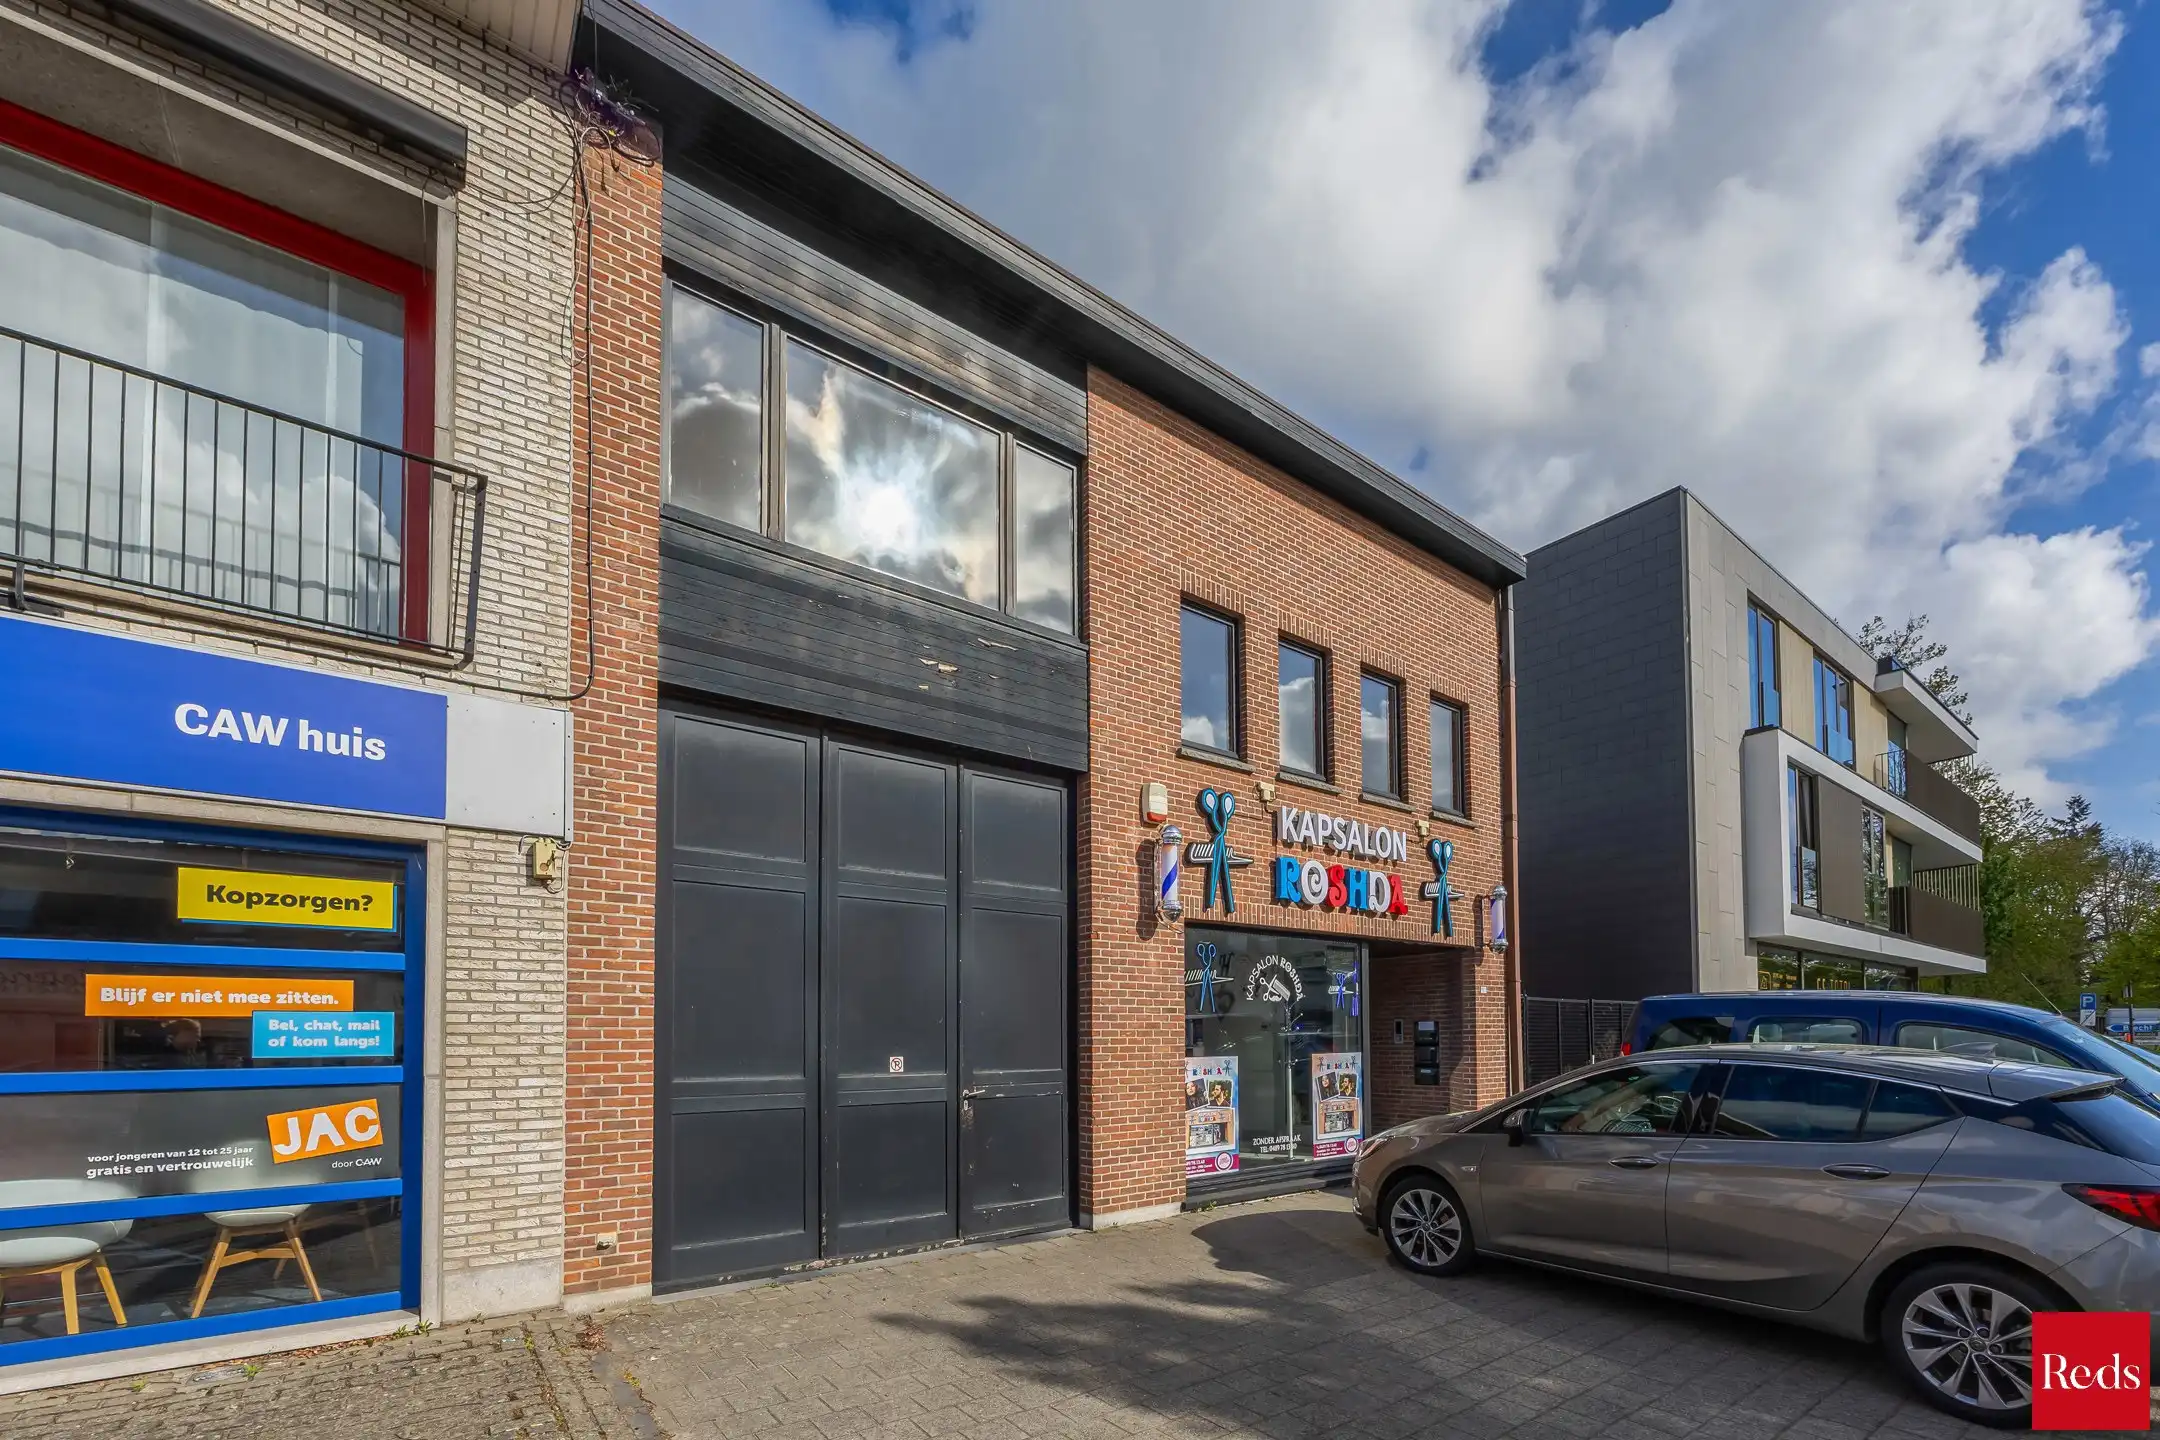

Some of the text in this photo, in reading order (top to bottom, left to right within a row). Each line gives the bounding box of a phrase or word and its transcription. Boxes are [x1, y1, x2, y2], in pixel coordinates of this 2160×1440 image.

[174, 703, 386, 761] CAW huis
[1278, 806, 1407, 862] KAPSALON
[1275, 856, 1408, 915] ROSHDA
[206, 884, 374, 913] Kopzorgen?
[1246, 955, 1304, 1001] KAPSALON ROSHDA
[100, 987, 339, 1006] Blijf er niet mee zitten.
[268, 1019, 381, 1032] Bel, chat, mail
[268, 1035, 380, 1049] of kom langs!
[273, 1106, 379, 1155] JAC
[1252, 1137, 1275, 1146] ZONDER
[87, 1146, 253, 1163] voor jongeren van 12 tot 25 jaar
[331, 1157, 382, 1169] door CAW
[86, 1157, 254, 1179] gratis en vertrouwelijk
